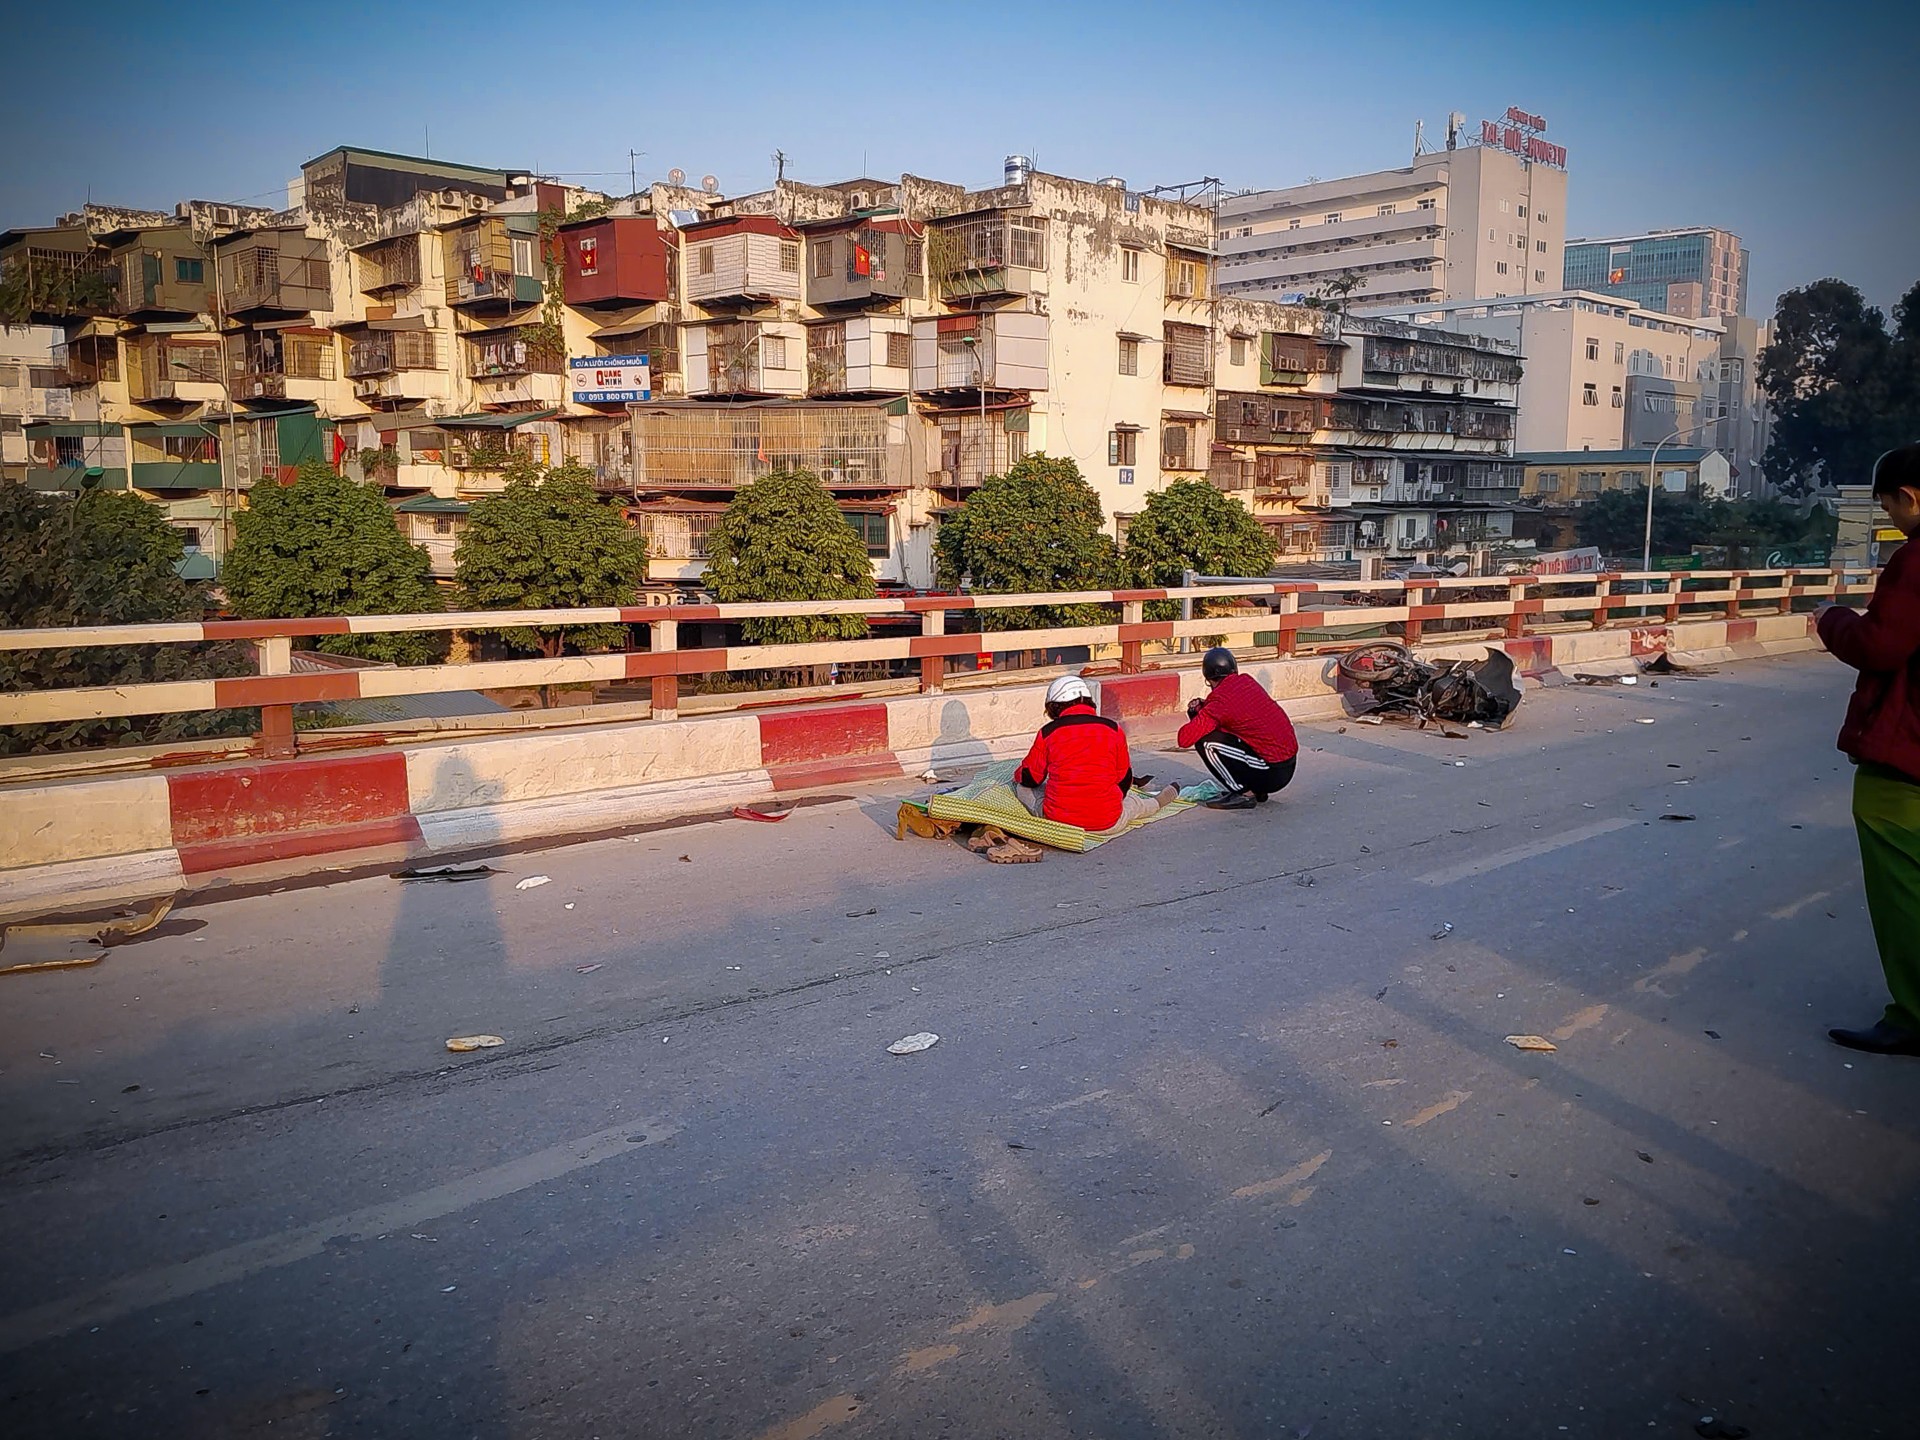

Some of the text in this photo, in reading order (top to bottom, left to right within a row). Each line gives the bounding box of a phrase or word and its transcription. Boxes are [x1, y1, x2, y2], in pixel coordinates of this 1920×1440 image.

[1126, 196, 1138, 210] H2
[596, 370, 622, 386] QUANG
[605, 377, 622, 386] MINH
[588, 393, 604, 401] 0913
[621, 392, 634, 400] 678
[1121, 471, 1133, 483] H2
